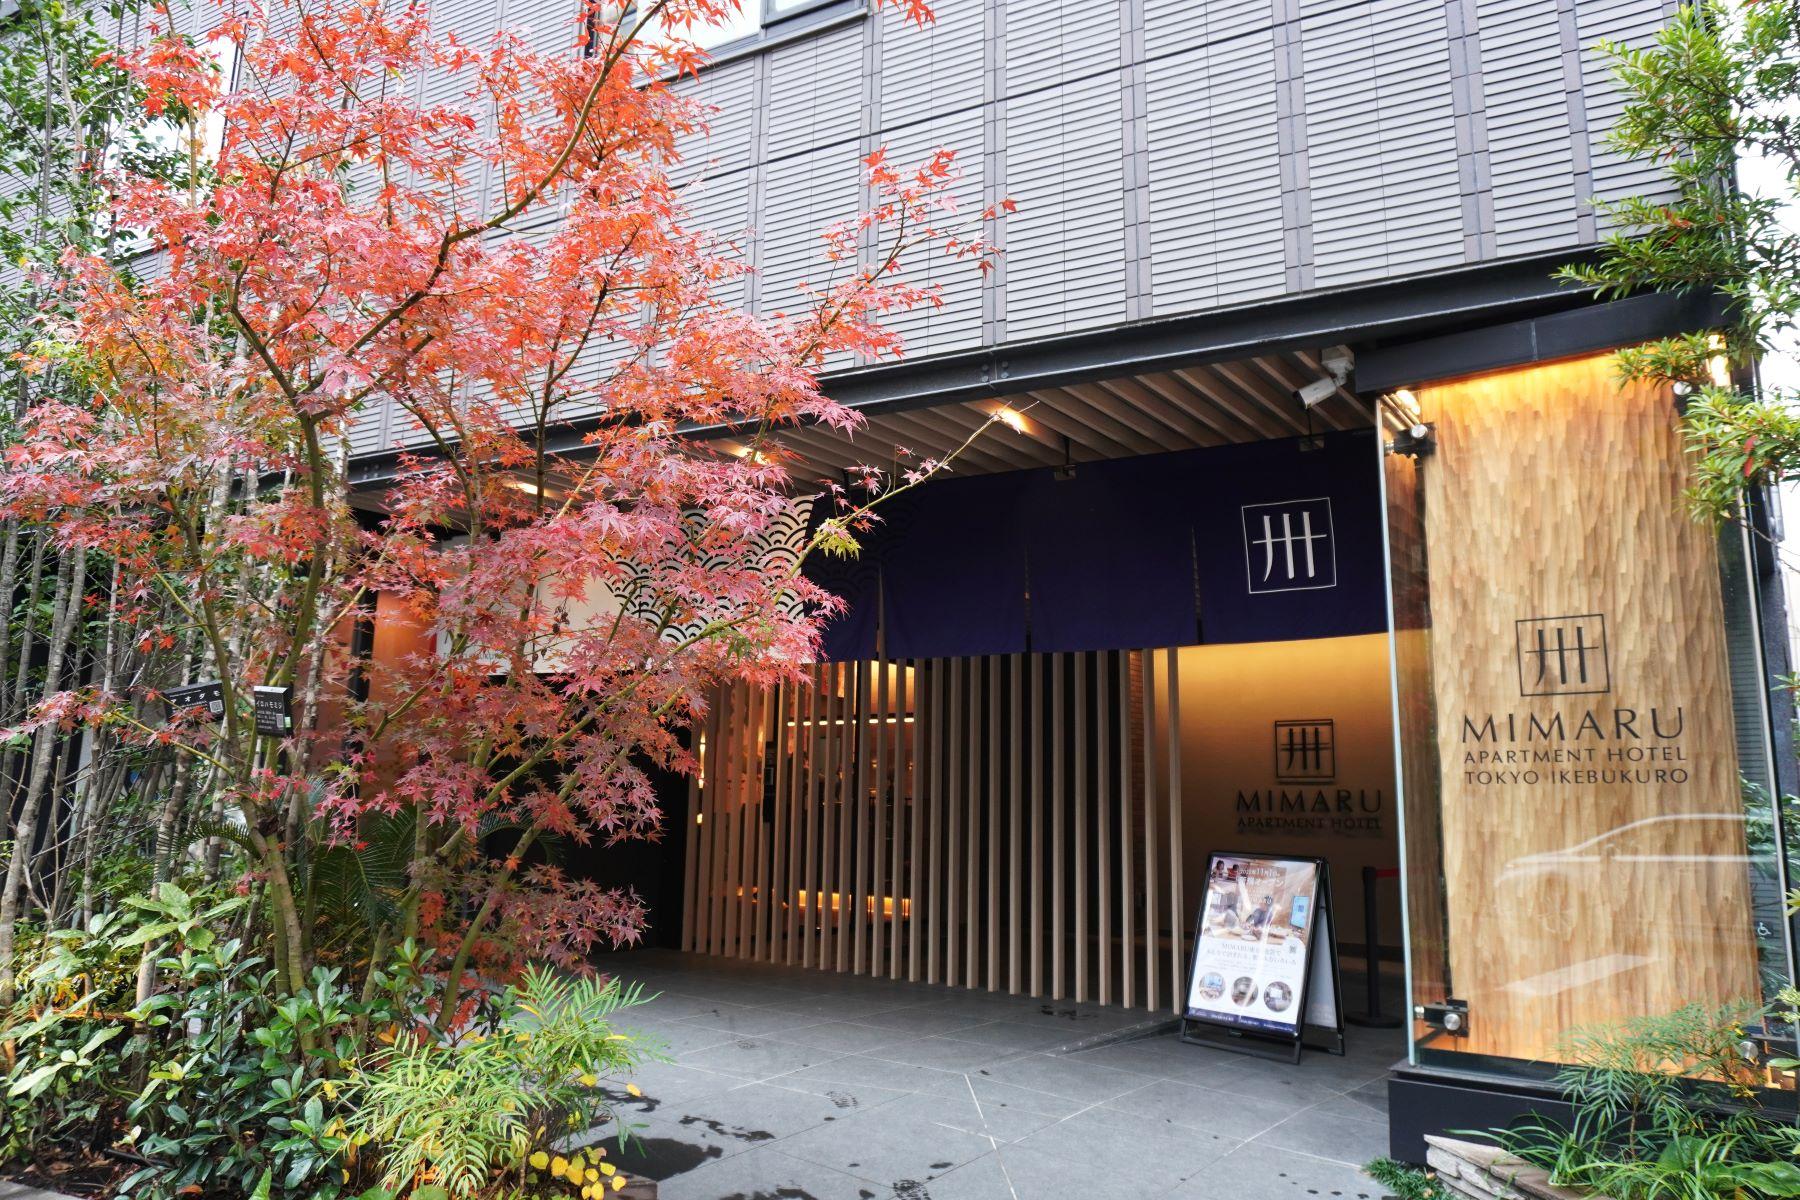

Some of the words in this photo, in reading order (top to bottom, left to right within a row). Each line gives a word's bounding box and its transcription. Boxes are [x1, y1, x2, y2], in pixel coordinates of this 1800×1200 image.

[1462, 706, 1684, 744] MIMARU
[1464, 748, 1596, 765] APARTMENT
[1607, 746, 1688, 763] HOTEL
[1465, 770, 1540, 786] TOKYO
[1551, 768, 1689, 785] IKEBUKURO
[1236, 789, 1382, 813] MIMARU
[1237, 816, 1325, 830] APARTMENT
[1331, 817, 1383, 831] HOTEL
